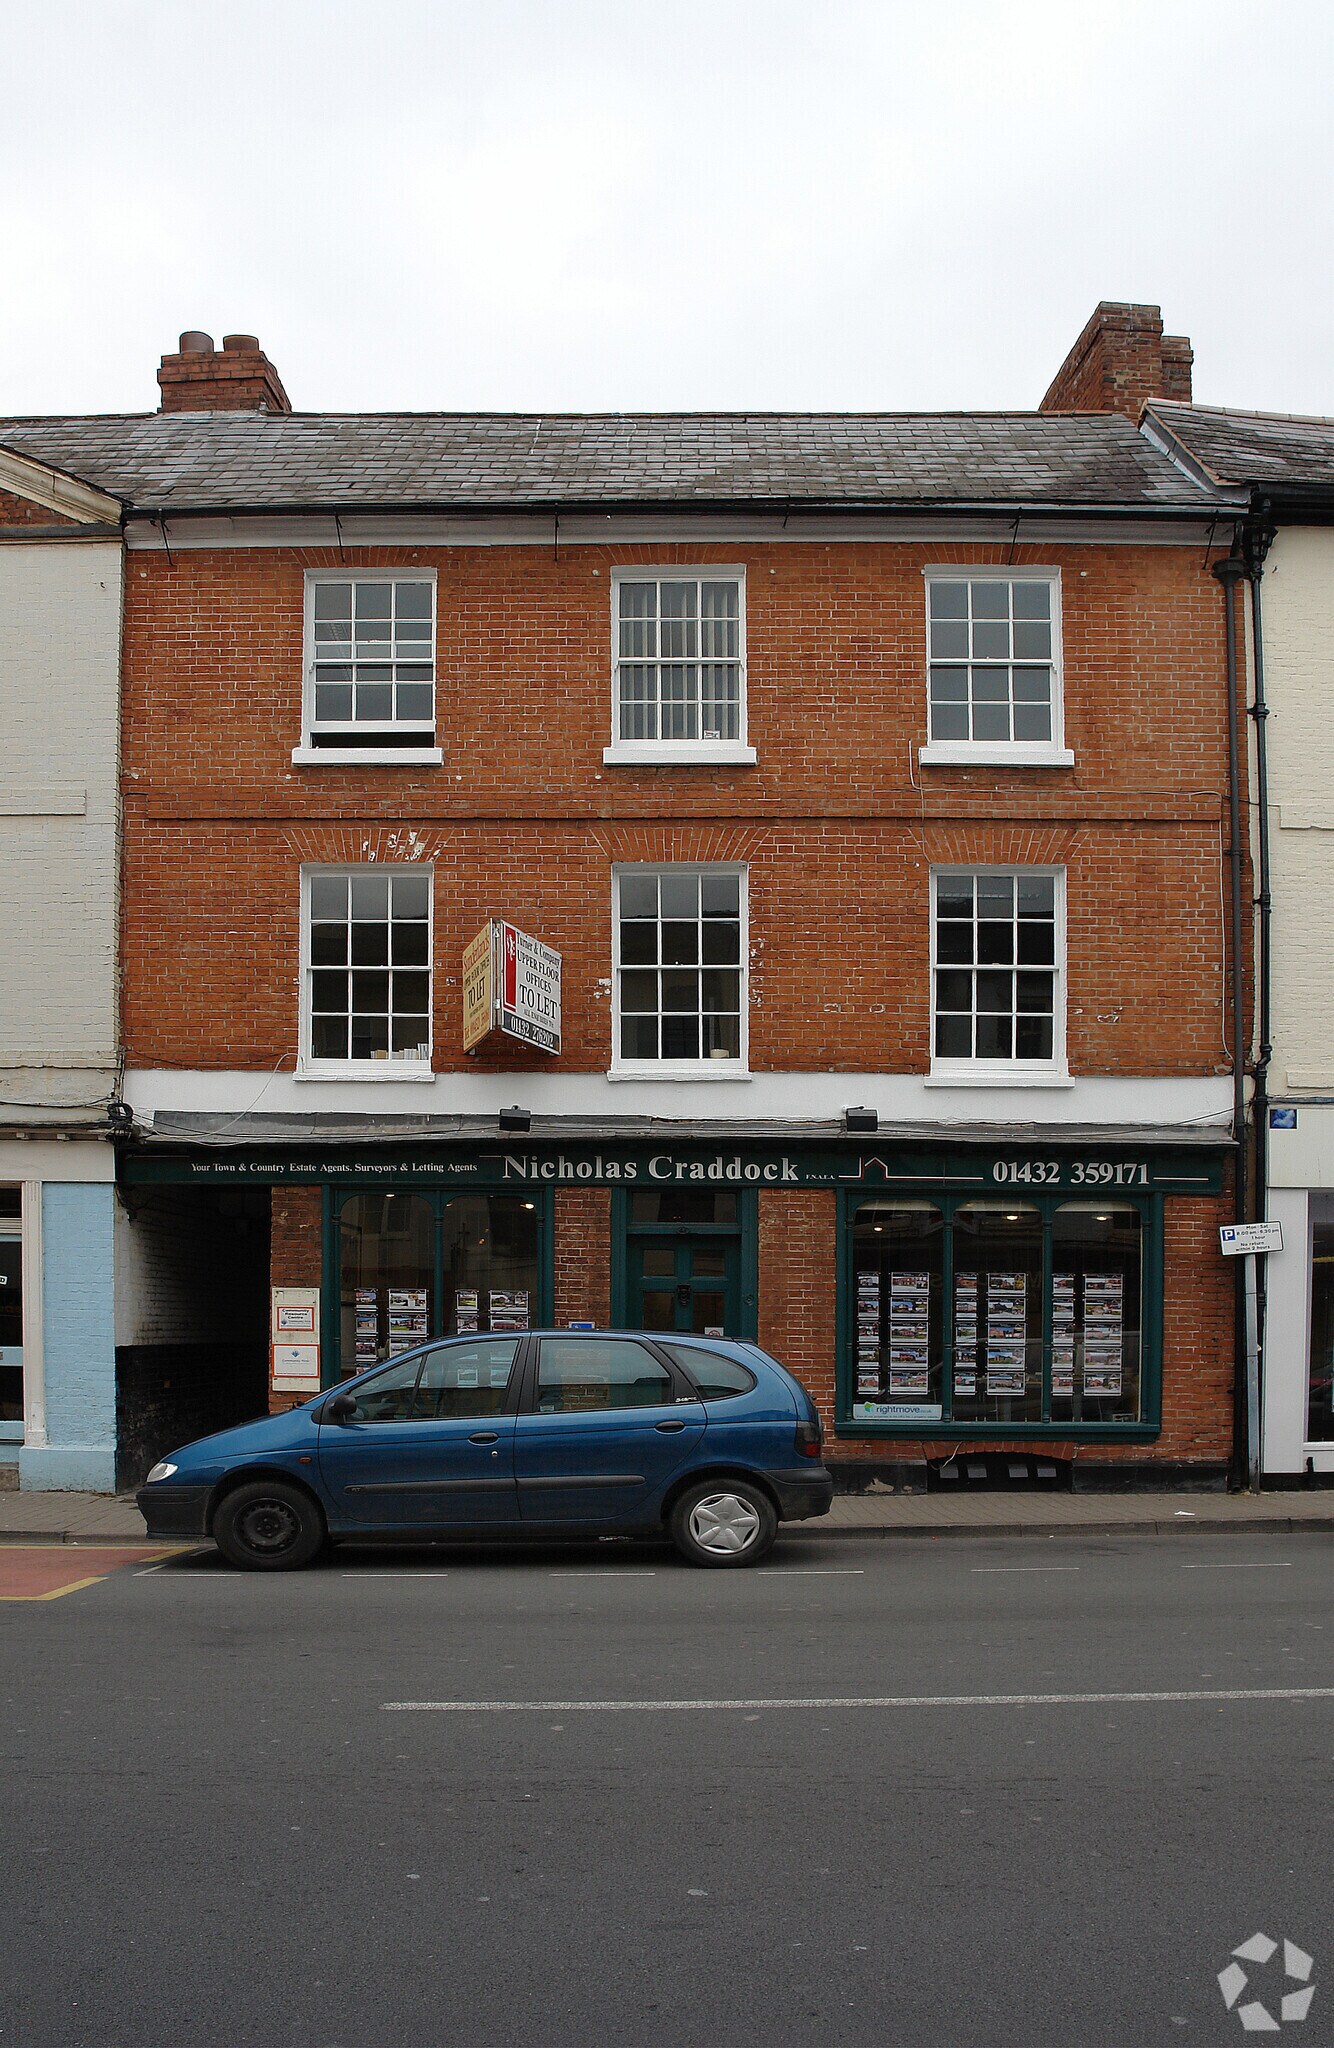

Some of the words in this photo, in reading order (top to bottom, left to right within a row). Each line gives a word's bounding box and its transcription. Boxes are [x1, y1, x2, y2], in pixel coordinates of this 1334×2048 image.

[516, 932, 532, 951] Turner
[534, 942, 538, 954] &
[540, 944, 560, 968] Company
[517, 950, 538, 970] UPPER
[538, 962, 559, 982] FLOOR
[468, 986, 476, 1009] TO
[477, 976, 485, 1001] LET
[526, 970, 552, 994] OFFICES
[519, 984, 534, 1008] TO
[537, 992, 558, 1020] LET
[511, 1016, 530, 1036] 01432
[191, 1163, 210, 1172] Your
[212, 1163, 236, 1172] Town
[238, 1163, 246, 1172] &
[250, 1163, 285, 1173] Country
[290, 1163, 316, 1172] Estate
[355, 1163, 397, 1174] Surveyors
[400, 1163, 408, 1172] &
[412, 1163, 444, 1172] Letting
[447, 1163, 478, 1172] Agents
[502, 1155, 638, 1179] Nicholas
[648, 1156, 799, 1181] Craddock
[992, 1161, 1061, 1183] 01432
[1070, 1162, 1150, 1185] 359171
